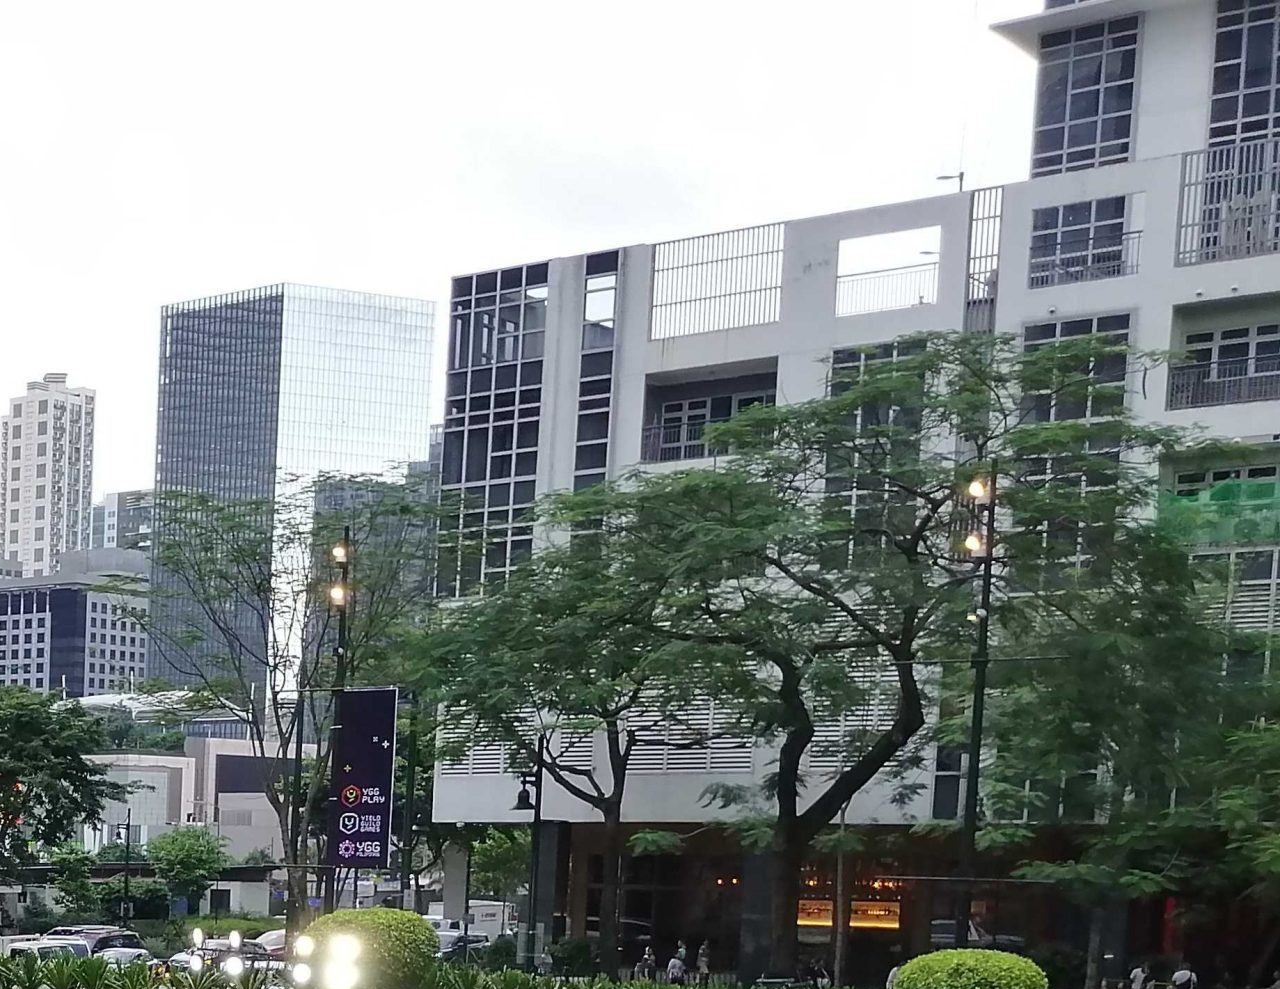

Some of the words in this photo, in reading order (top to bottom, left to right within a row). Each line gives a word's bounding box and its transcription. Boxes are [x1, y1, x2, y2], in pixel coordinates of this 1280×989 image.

[362, 788, 380, 796] YGG
[362, 796, 385, 804] PLAY
[356, 841, 381, 852] YGG
